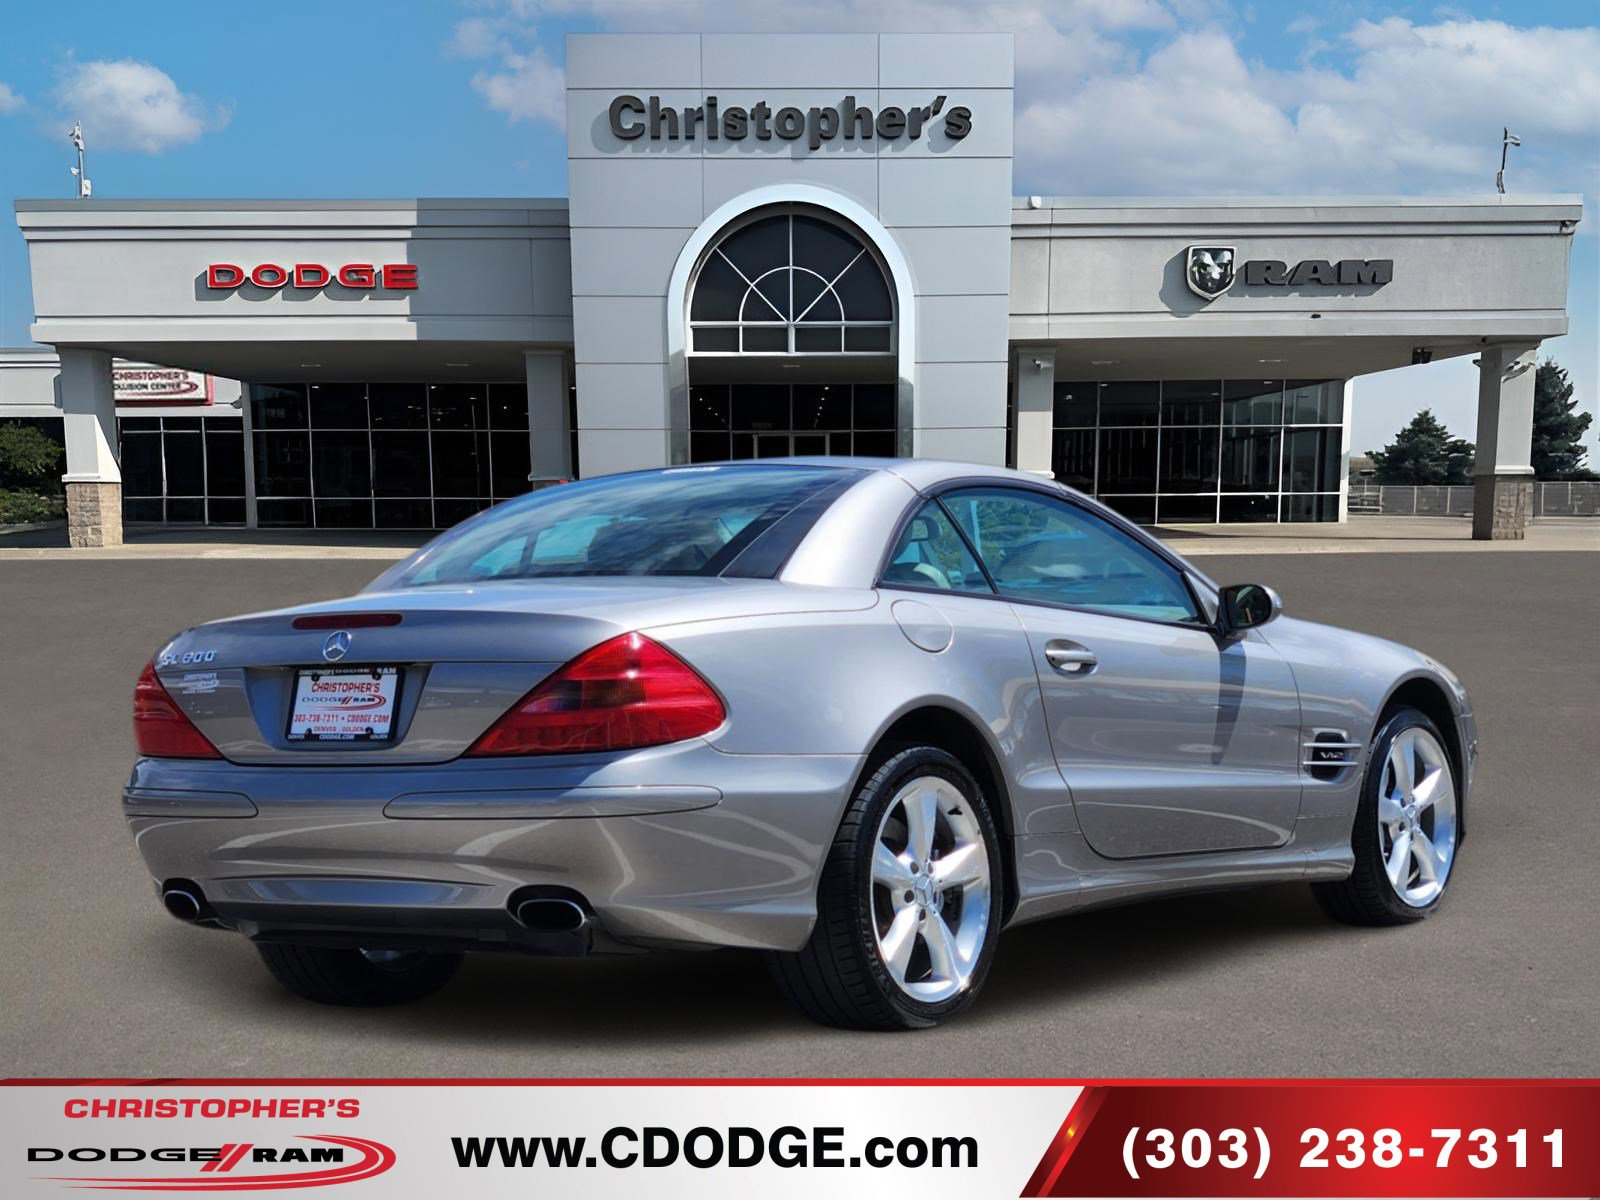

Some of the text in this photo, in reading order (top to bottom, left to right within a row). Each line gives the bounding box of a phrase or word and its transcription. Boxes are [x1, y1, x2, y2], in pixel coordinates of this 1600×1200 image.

[608, 95, 972, 150] Christopher's
[207, 263, 418, 288] DODGE
[1245, 259, 1393, 285] RAM
[150, 382, 180, 390] CENTER
[311, 682, 380, 693] CHRISTOPHER'S
[294, 714, 389, 723] 303-238-7311 CDODGE.COM
